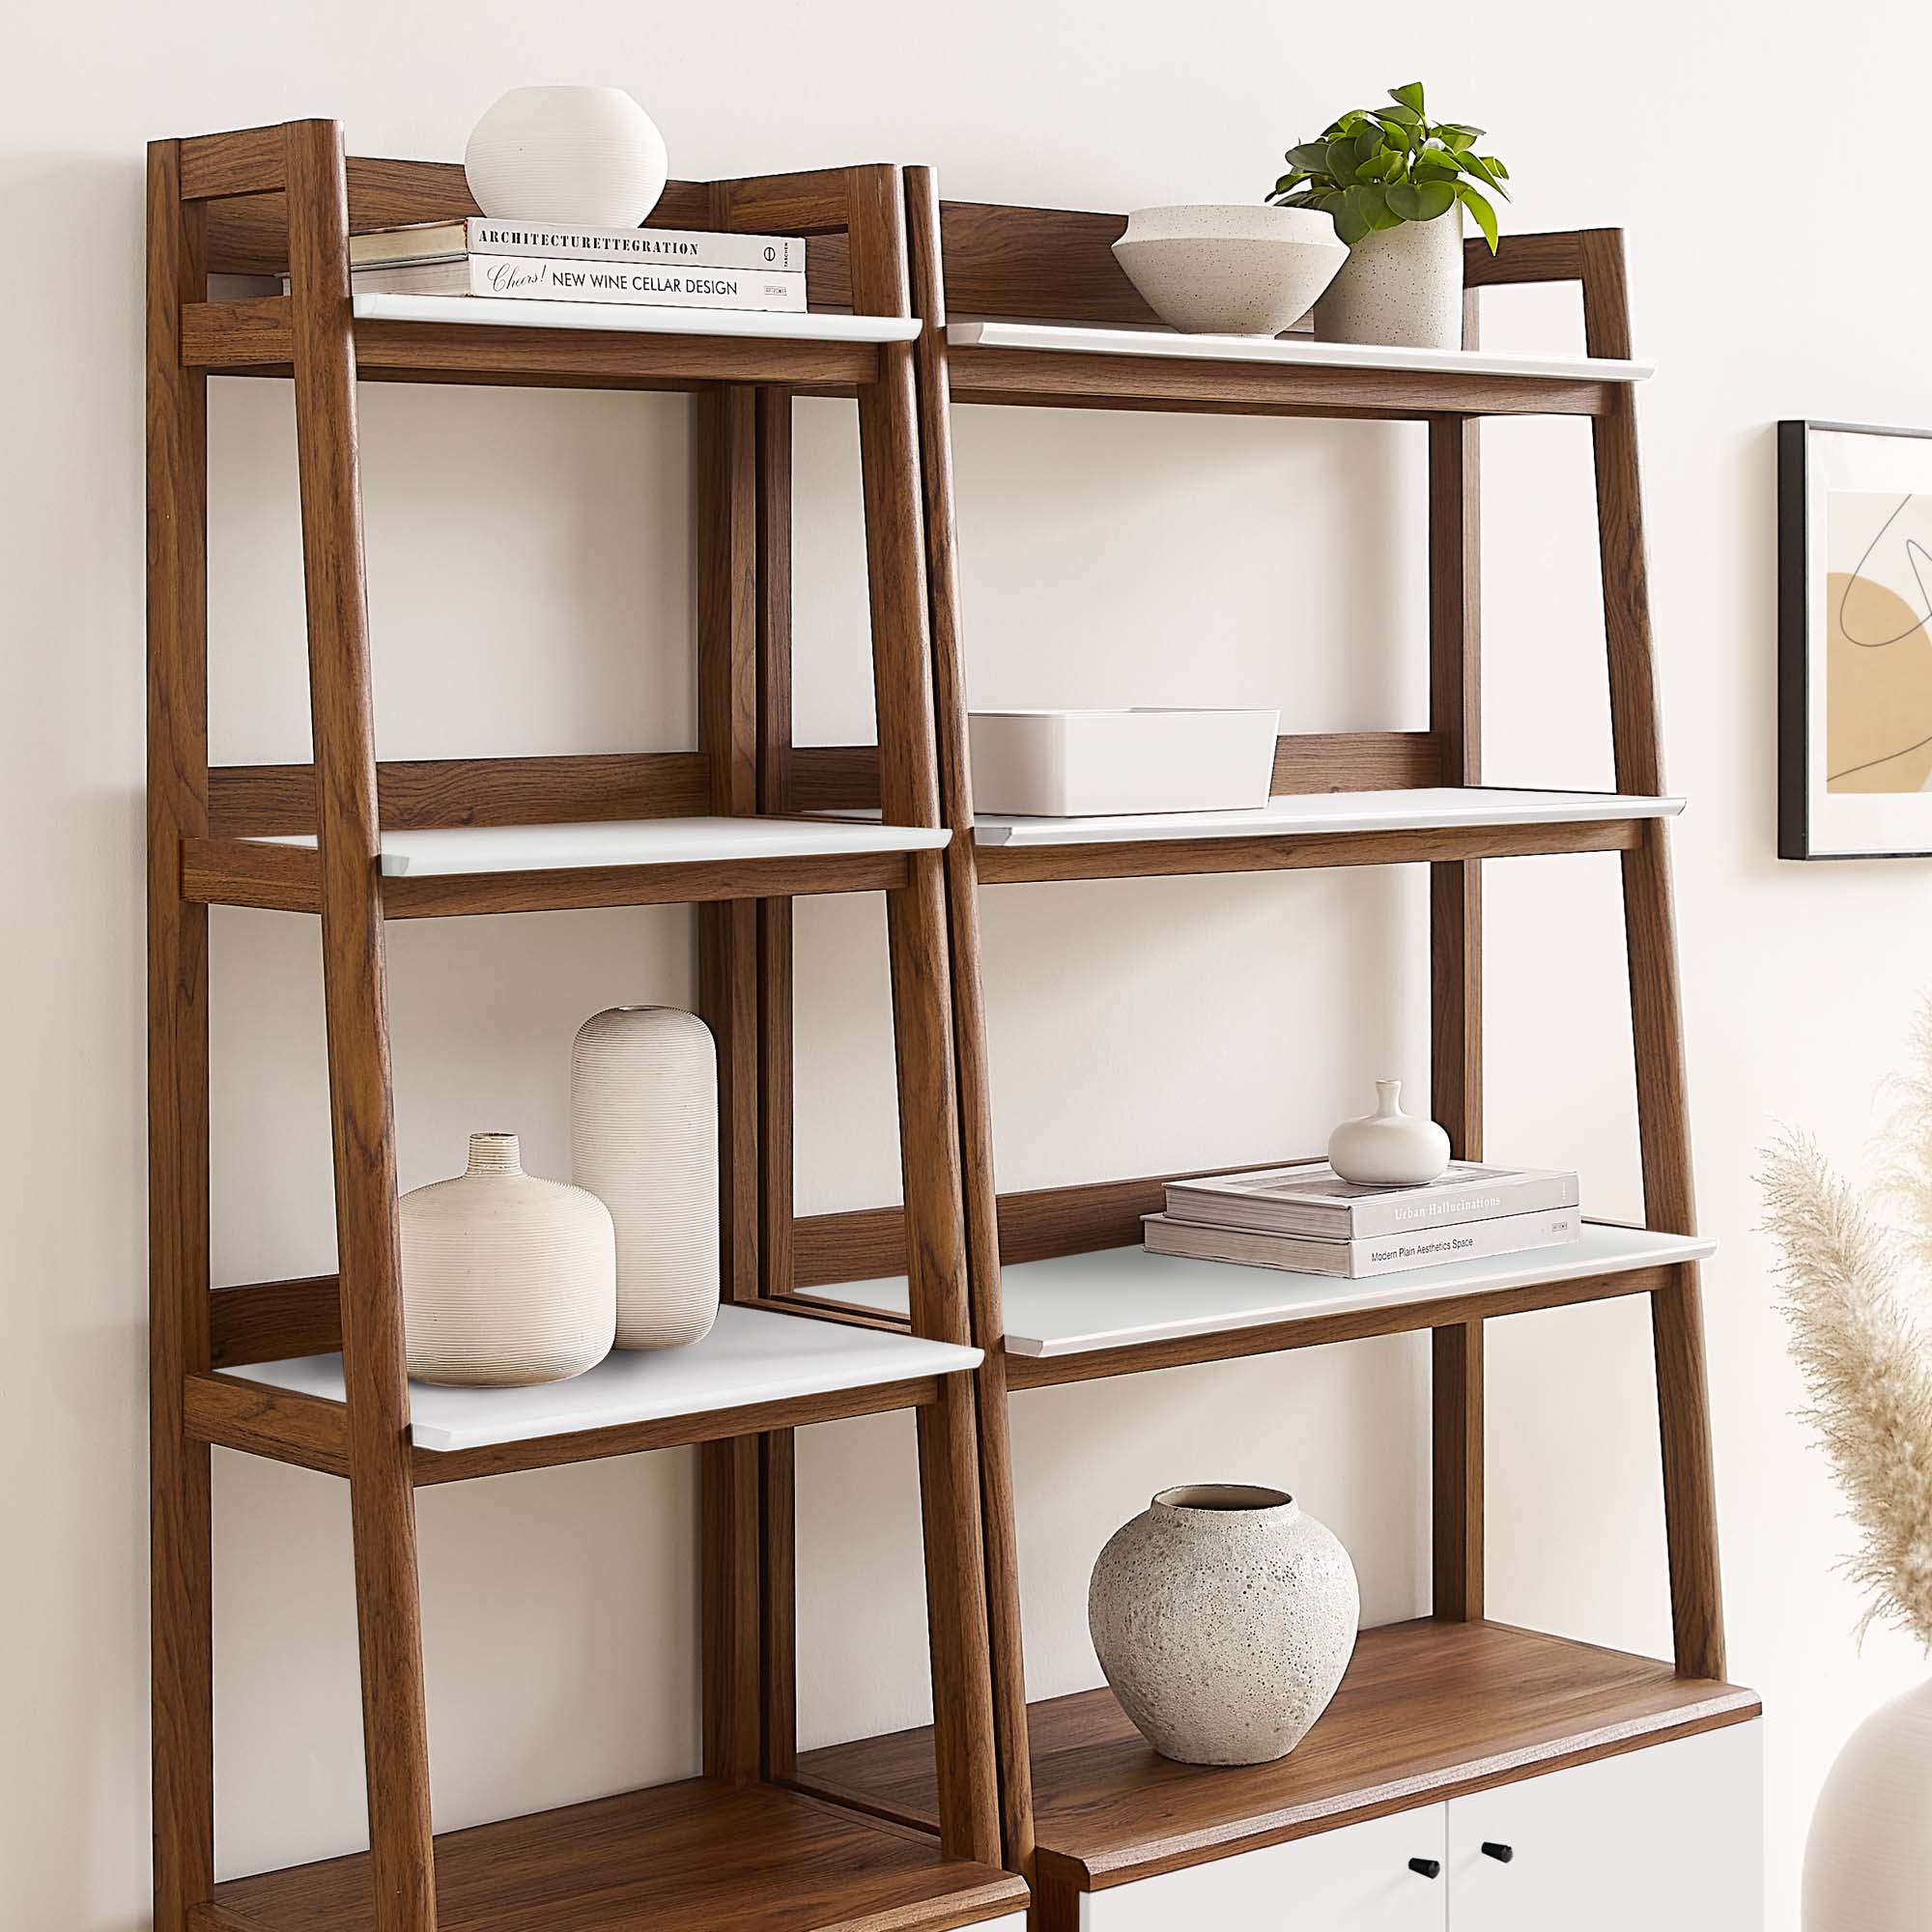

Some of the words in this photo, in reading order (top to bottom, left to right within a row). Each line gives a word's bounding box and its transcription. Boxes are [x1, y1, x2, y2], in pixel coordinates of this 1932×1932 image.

[479, 230, 698, 255] ARCHITECTURETTEGRATION
[487, 263, 547, 292] Cheers!
[553, 272, 585, 287] NEW
[590, 274, 628, 290] WINE
[632, 276, 682, 293] CELLAR
[686, 279, 737, 295] DESIGN
[1395, 1207, 1425, 1220] Urban
[1430, 1197, 1500, 1215] Hallucinations
[1372, 1251, 1398, 1262] Modern
[1399, 1246, 1415, 1258] Plain
[1417, 1241, 1451, 1255] Aesthetics
[1452, 1237, 1473, 1250] Space
